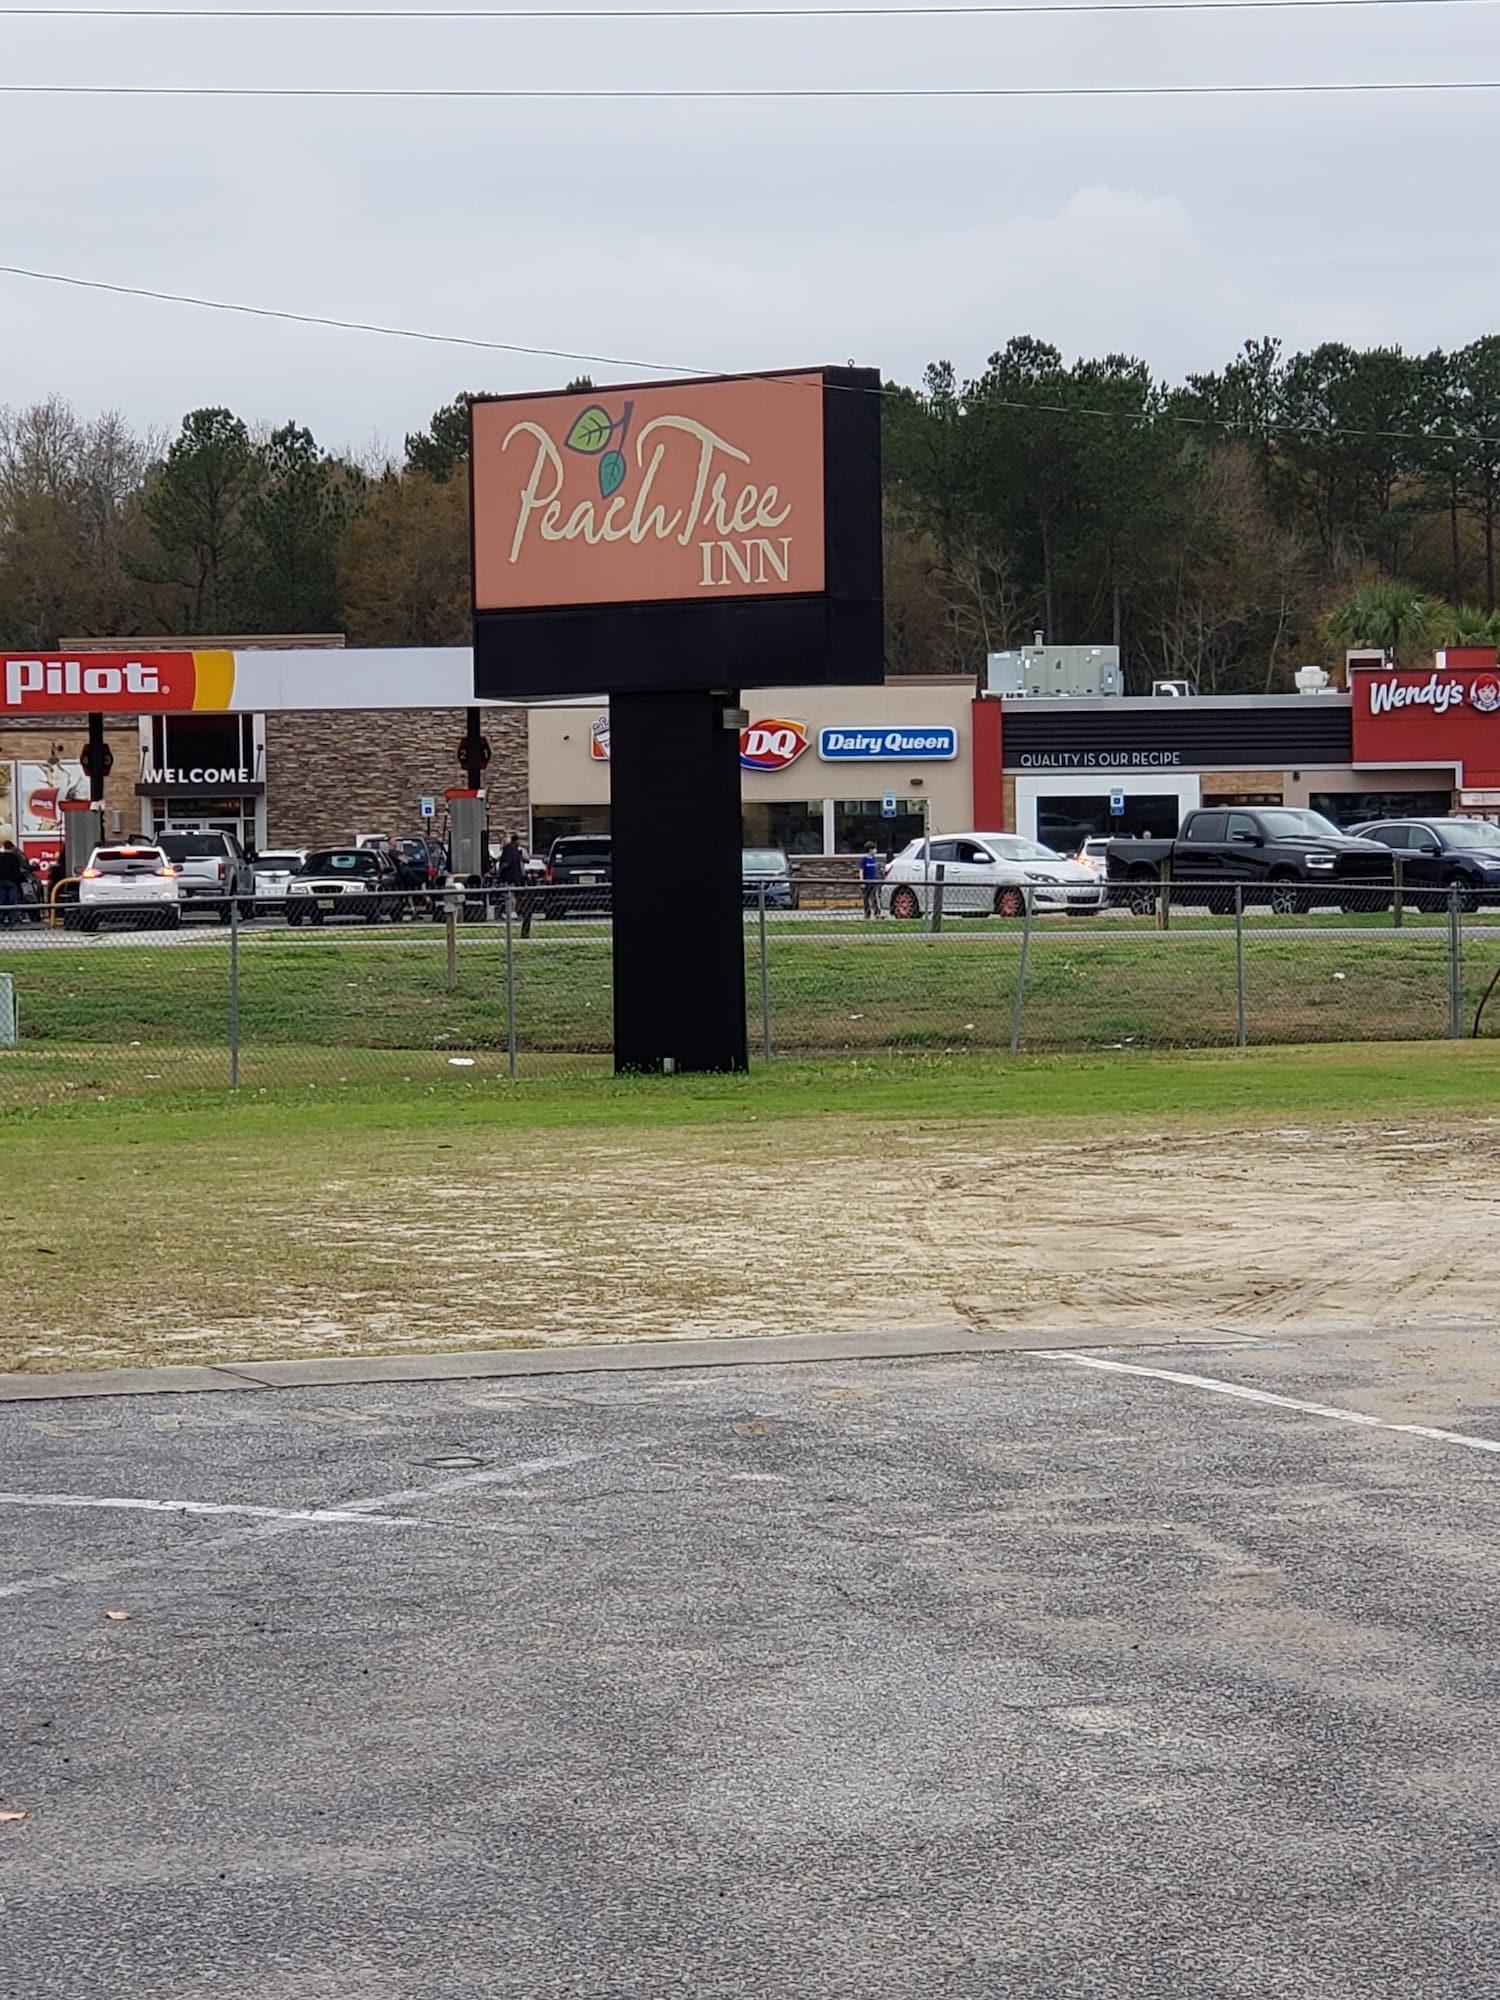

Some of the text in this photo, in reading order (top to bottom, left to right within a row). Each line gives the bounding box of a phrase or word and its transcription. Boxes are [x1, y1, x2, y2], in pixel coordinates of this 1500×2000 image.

[698, 537, 793, 587] INN
[1369, 674, 1464, 715] Wendy's
[745, 729, 797, 759] DQ
[827, 732, 950, 754] Dairy Queen
[1020, 751, 1181, 767] QUALITY IS OUR RECIPE
